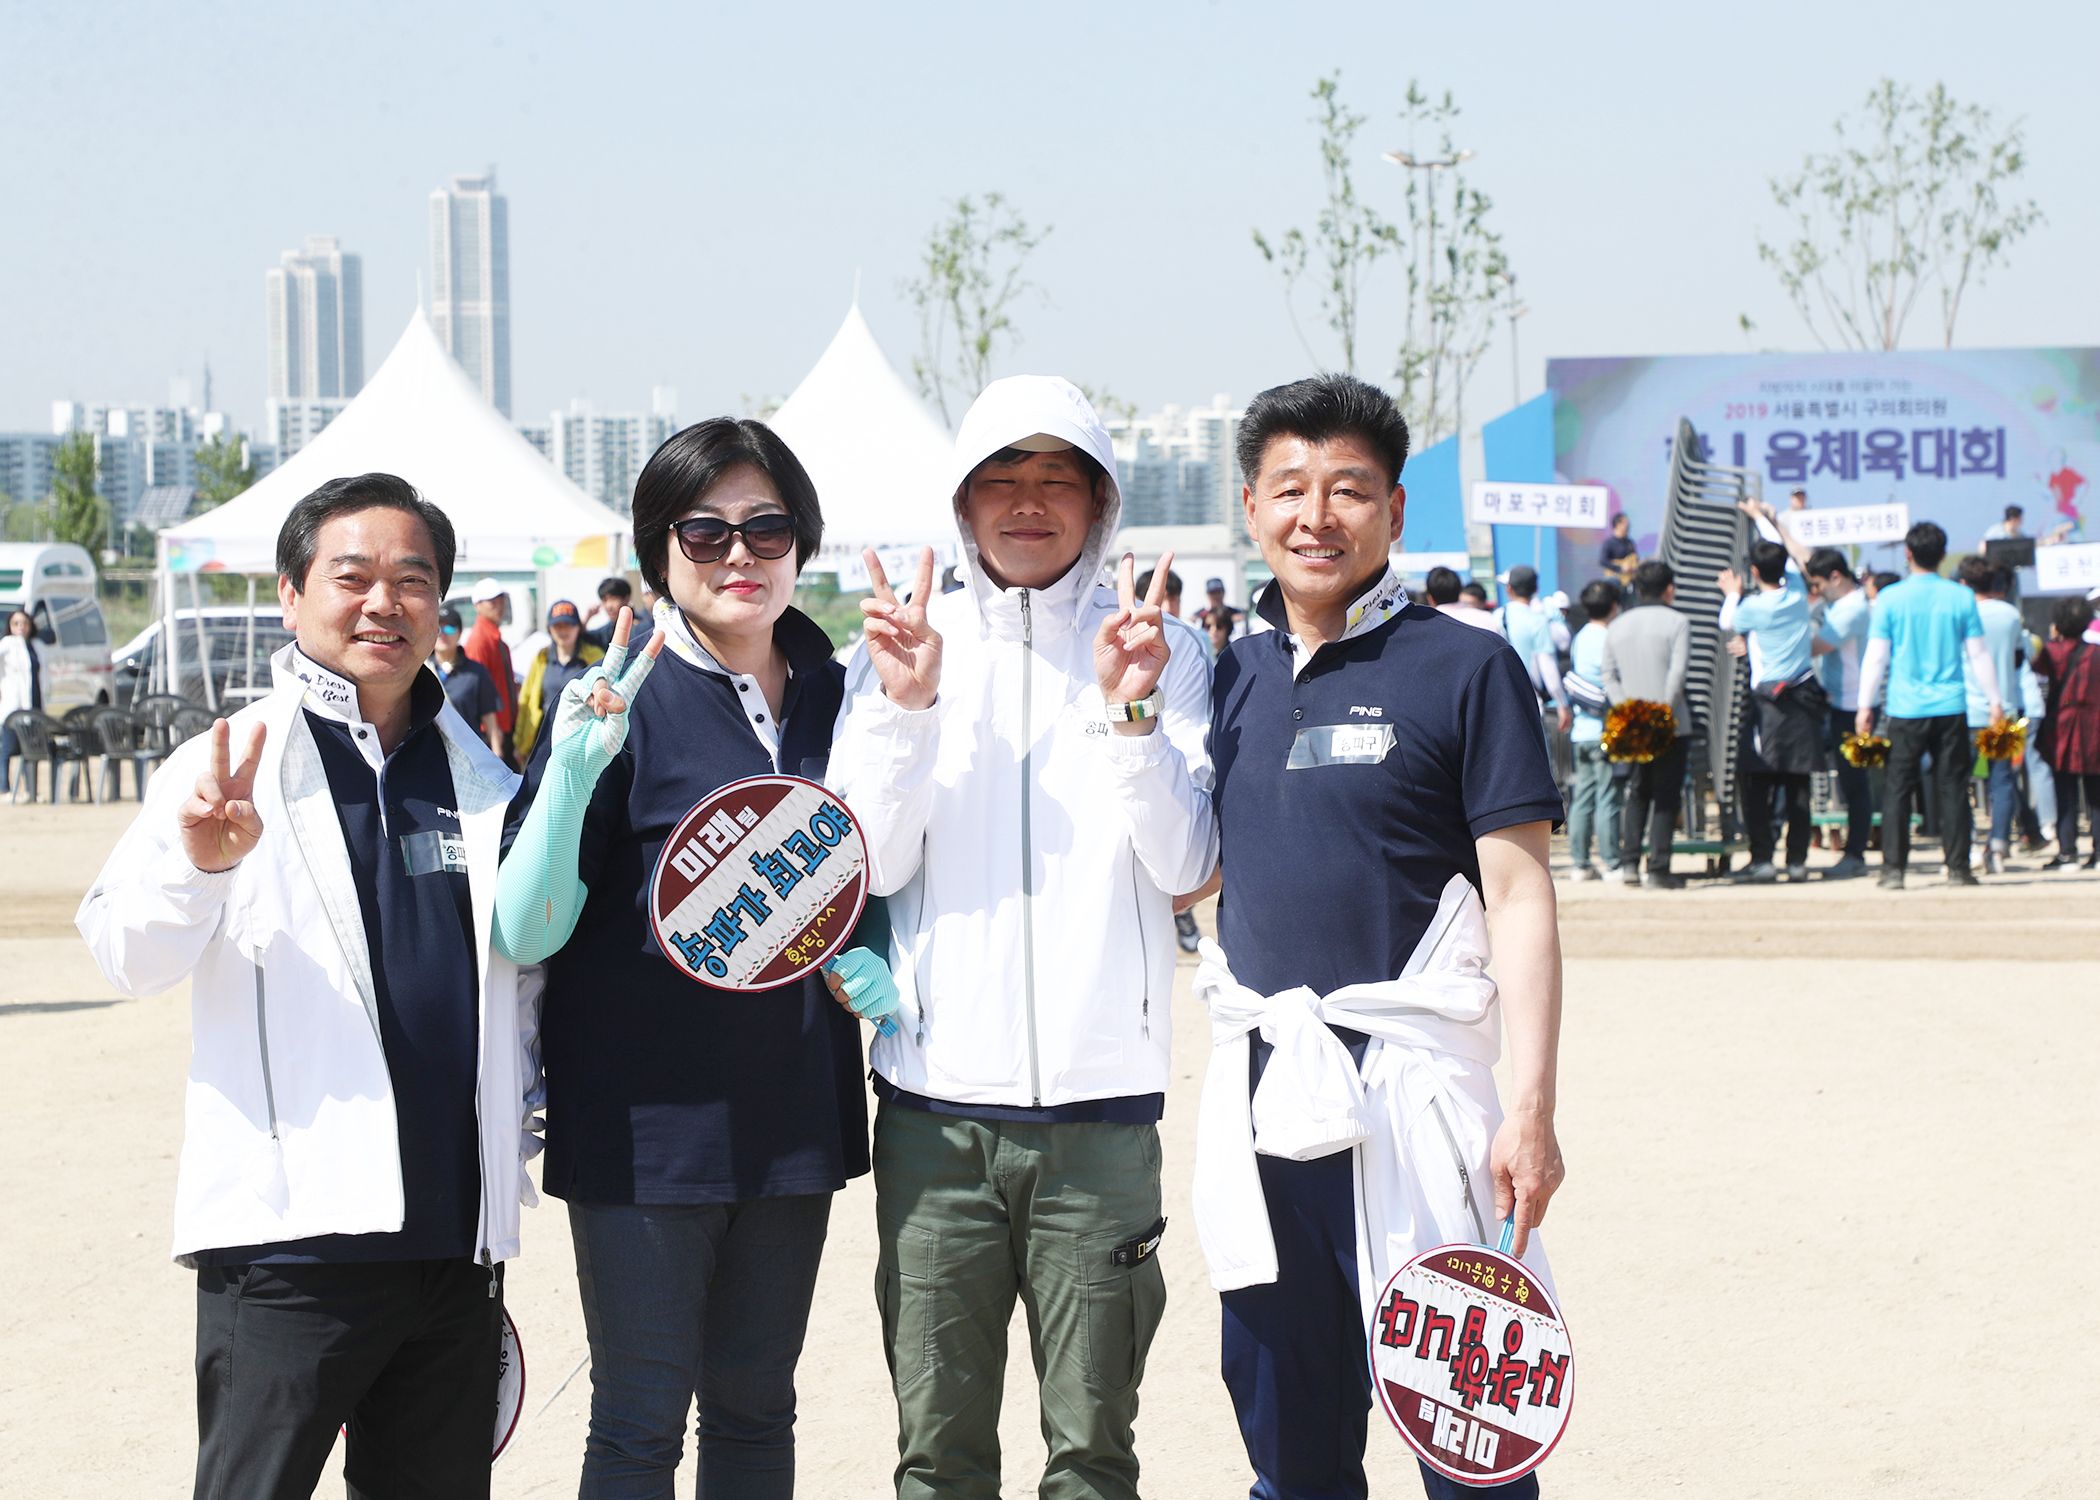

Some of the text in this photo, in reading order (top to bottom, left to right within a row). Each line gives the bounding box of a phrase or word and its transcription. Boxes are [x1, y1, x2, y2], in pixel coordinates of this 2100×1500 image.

[1724, 402, 1768, 420] 2019
[1774, 401, 1858, 420] 서울특별시
[1664, 427, 2006, 483] 음체육대회
[1484, 491, 1596, 518] 마포구의회
[316, 673, 347, 691] Dress
[322, 689, 350, 704] Best
[1349, 705, 1383, 717] PING
[1341, 736, 1377, 752] 송파구
[668, 800, 853, 979] 송파가 최고야
[1446, 1256, 1530, 1305] 할 수 있습니다
[1379, 1288, 1571, 1417] 사랑합니다
